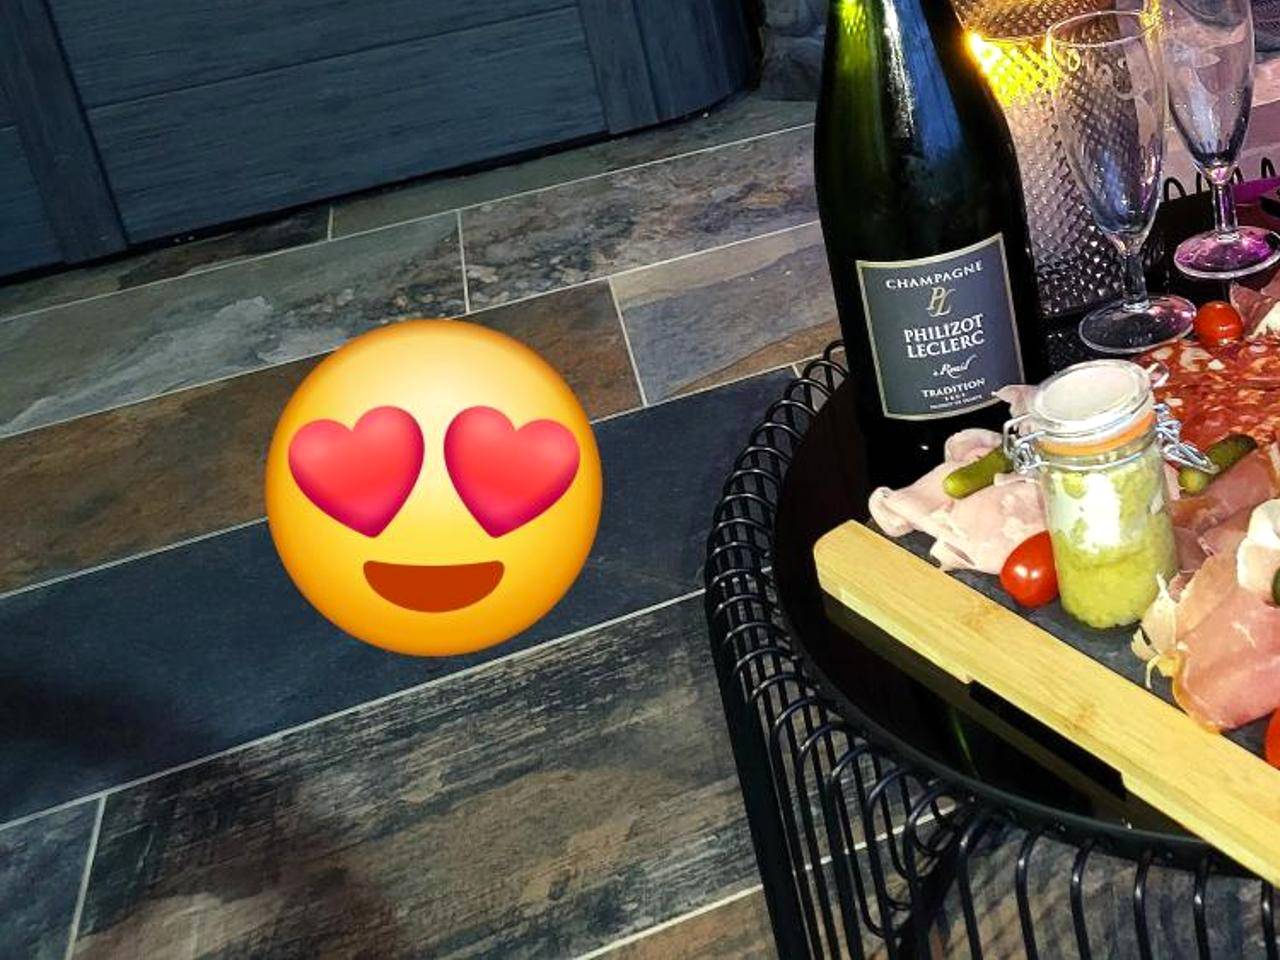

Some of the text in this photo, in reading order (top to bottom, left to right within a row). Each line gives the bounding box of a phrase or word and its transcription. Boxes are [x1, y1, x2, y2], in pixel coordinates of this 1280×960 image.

[885, 259, 984, 290] CHAMPAGNE
[903, 313, 984, 343] PHILIZOT
[907, 330, 986, 359] LECLERC
[920, 377, 986, 398] TRADITION
